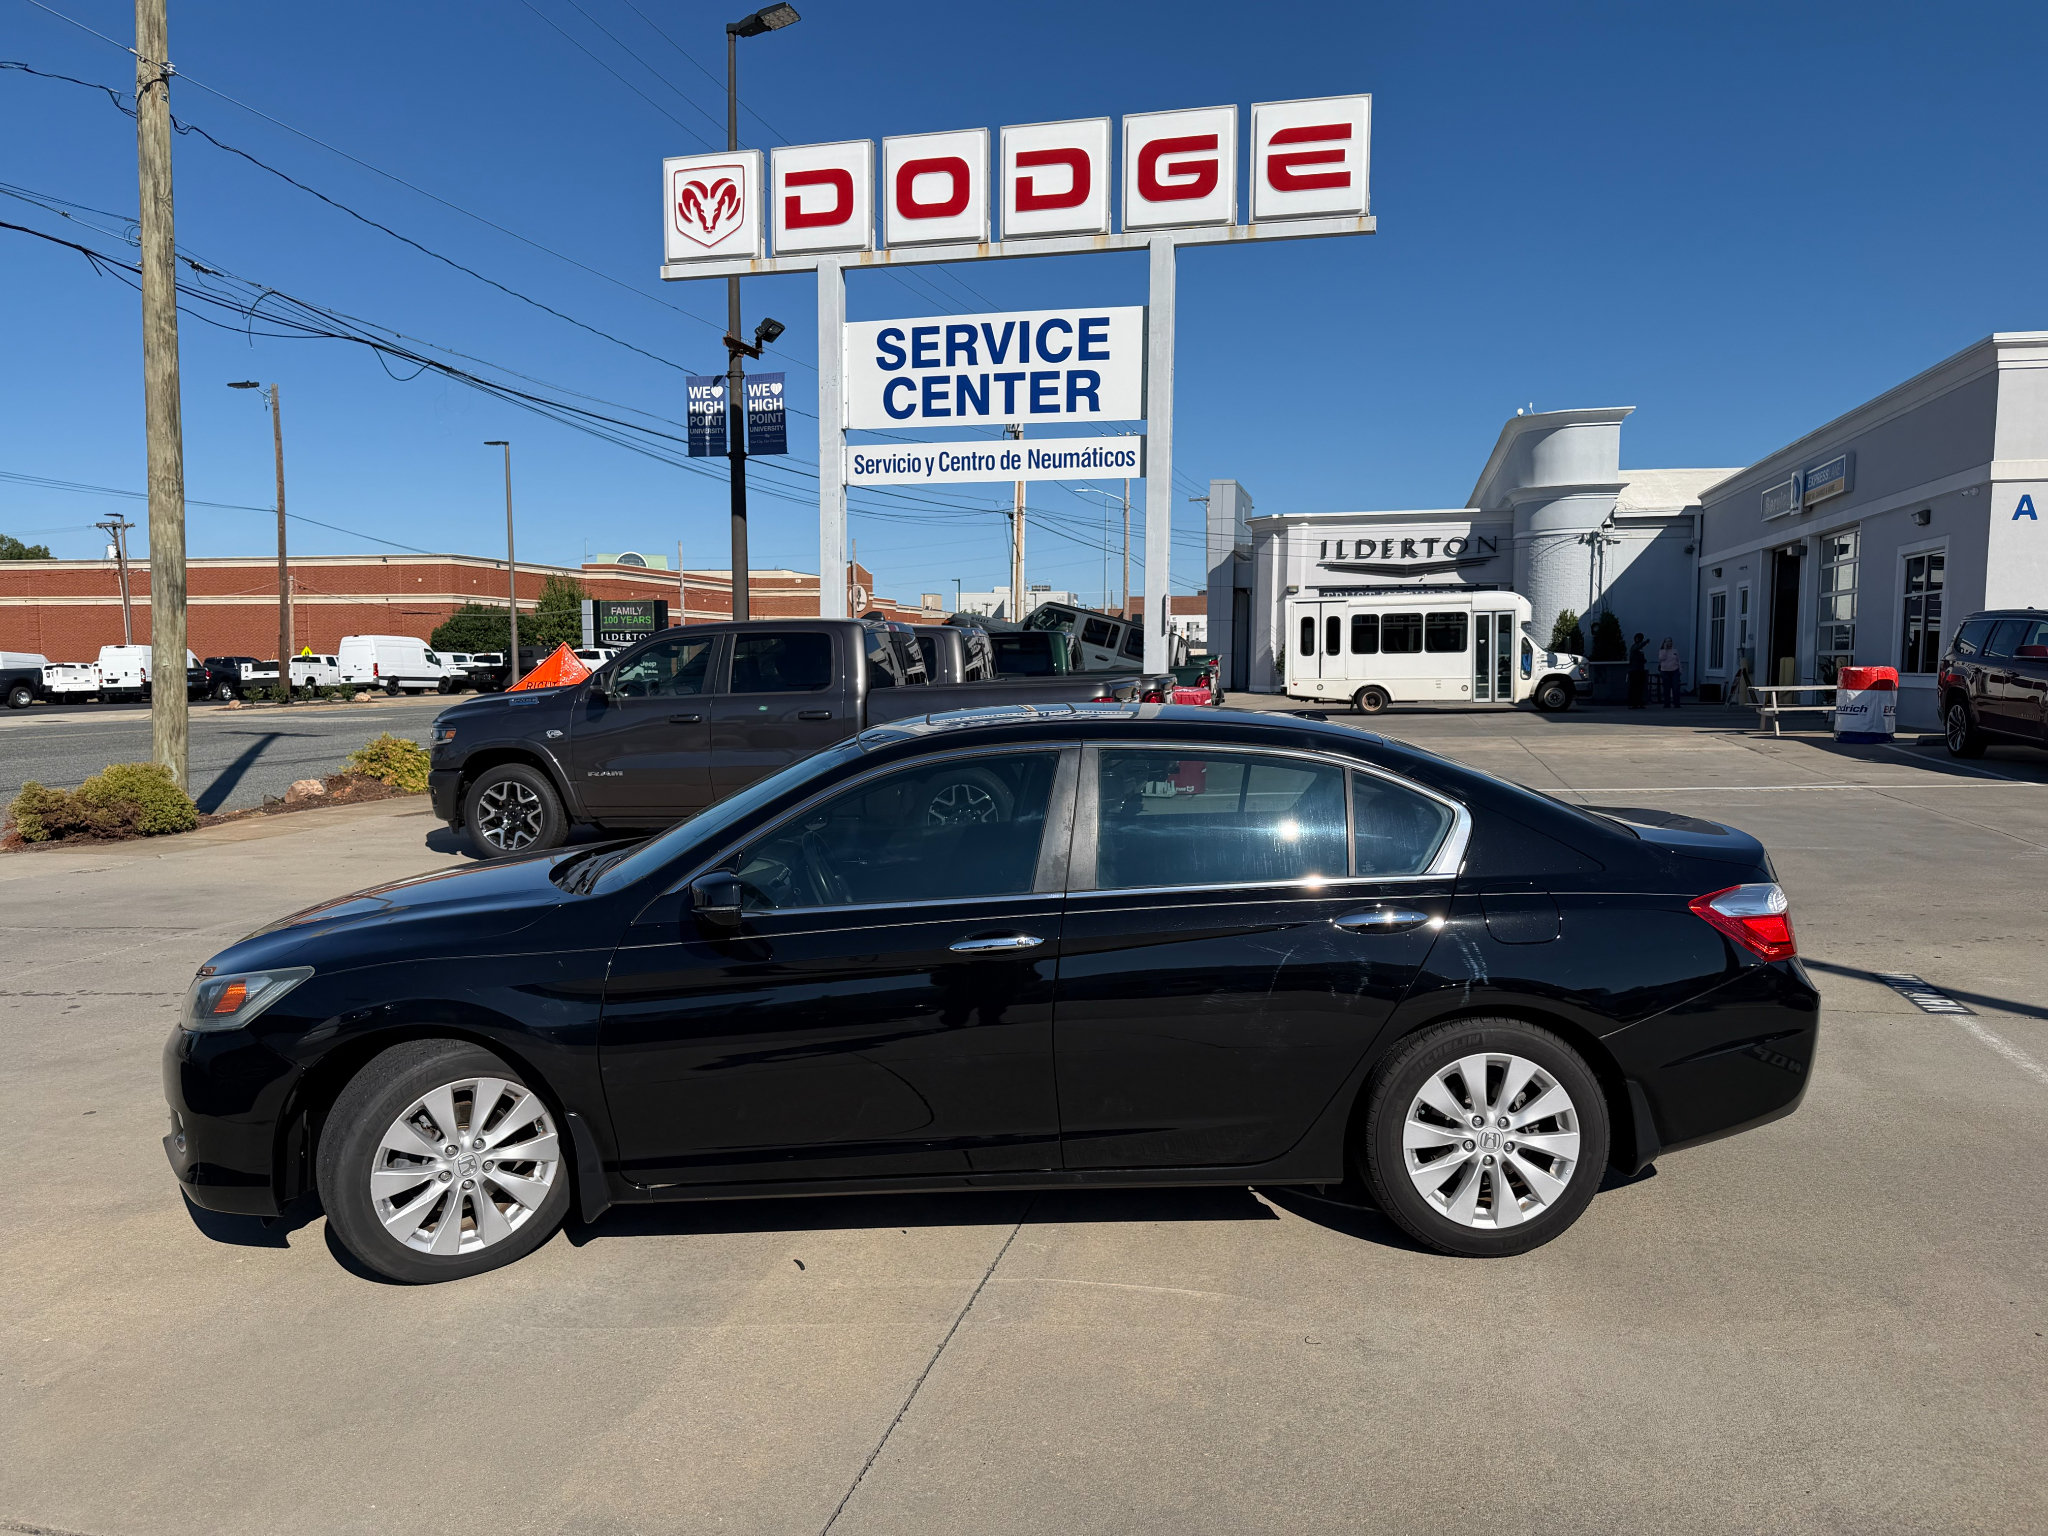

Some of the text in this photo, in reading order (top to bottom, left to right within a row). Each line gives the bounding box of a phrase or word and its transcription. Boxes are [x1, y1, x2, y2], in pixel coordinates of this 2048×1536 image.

[785, 123, 1352, 230] DODGE
[876, 317, 1110, 371] SERVICE
[688, 386, 711, 399] WE
[748, 384, 770, 397] WE
[883, 370, 1101, 420] CENTER
[689, 401, 724, 414] HIGH
[748, 398, 783, 412] HIGH
[690, 415, 724, 426] POINT
[749, 413, 783, 424] POINT
[749, 424, 784, 433] UNIVERSITY
[854, 447, 1136, 477] Servicio y Centro de Neumáticos
[2011, 494, 2038, 520] A
[1320, 536, 1497, 560] ILDERTON
[611, 607, 643, 615] FAMILY
[604, 616, 651, 624] 100 YEARS
[601, 633, 652, 641] ILDERTO
